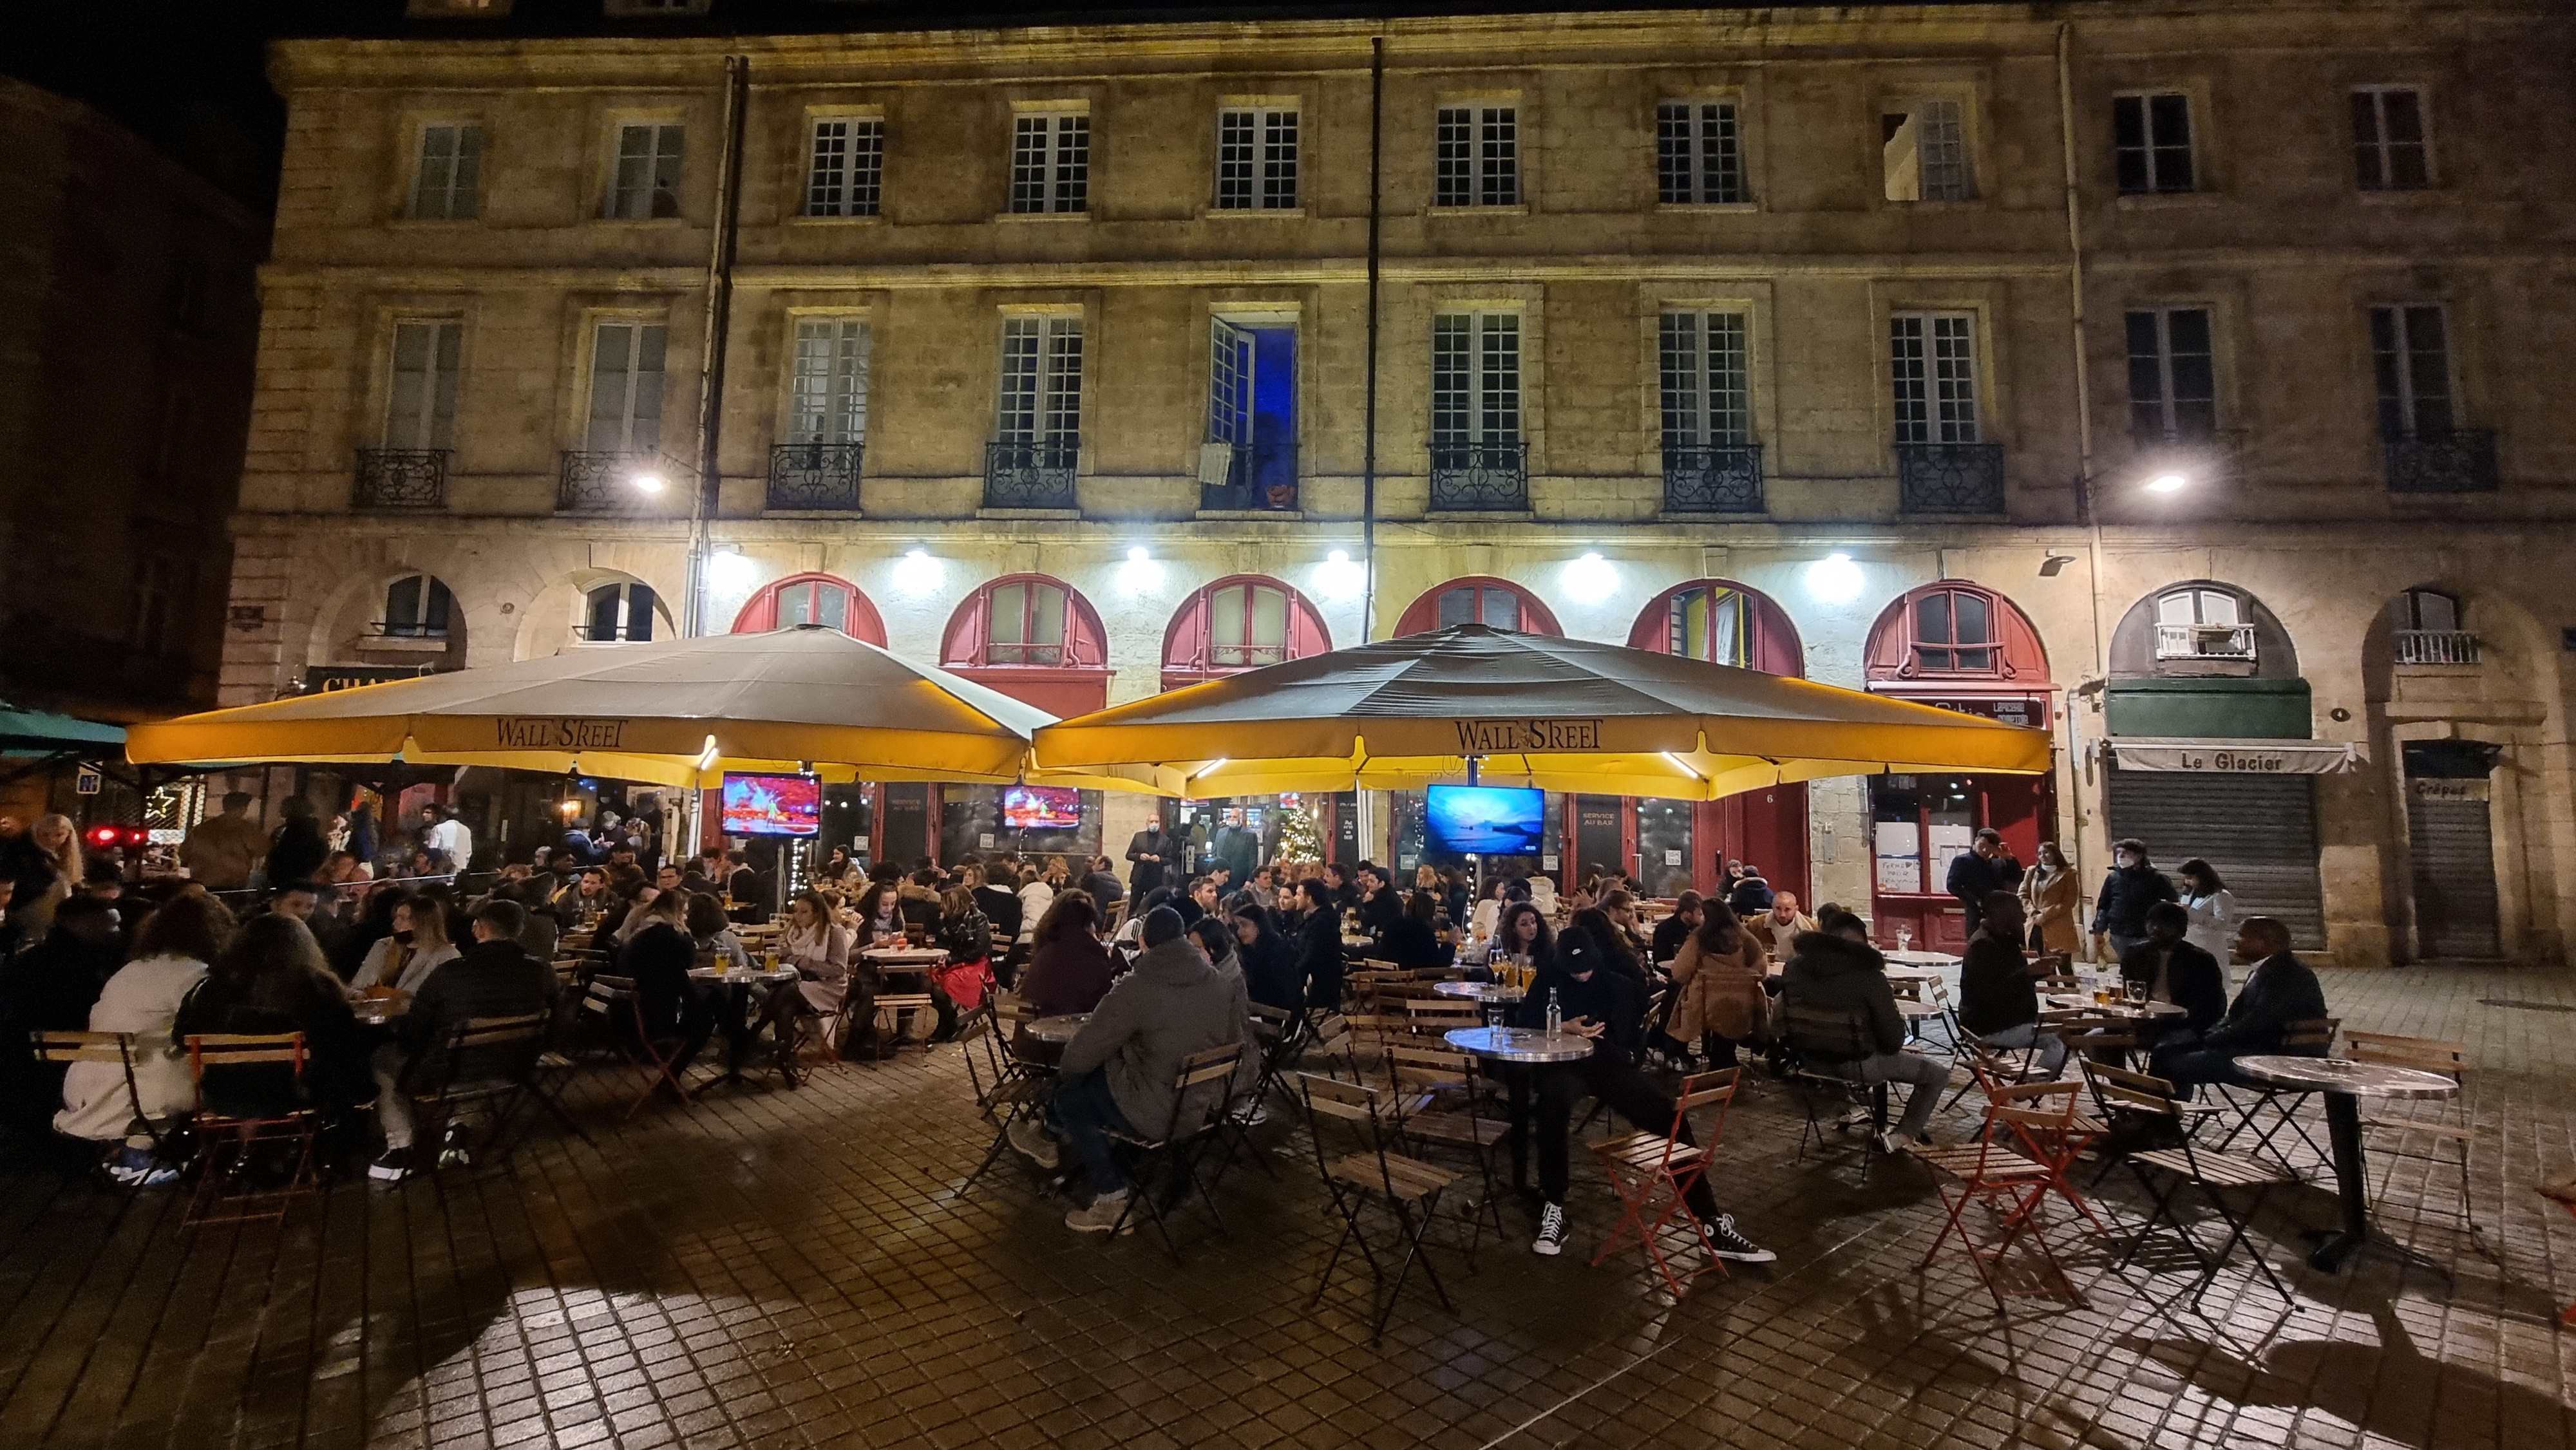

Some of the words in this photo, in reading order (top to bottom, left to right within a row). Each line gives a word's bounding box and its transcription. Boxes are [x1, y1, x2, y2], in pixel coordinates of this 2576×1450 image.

[497, 718, 554, 746] WALL
[1454, 720, 1519, 749] WALL
[2181, 752, 2202, 769] Le
[2214, 753, 2282, 771] Glacier
[1766, 794, 1774, 804] 6
